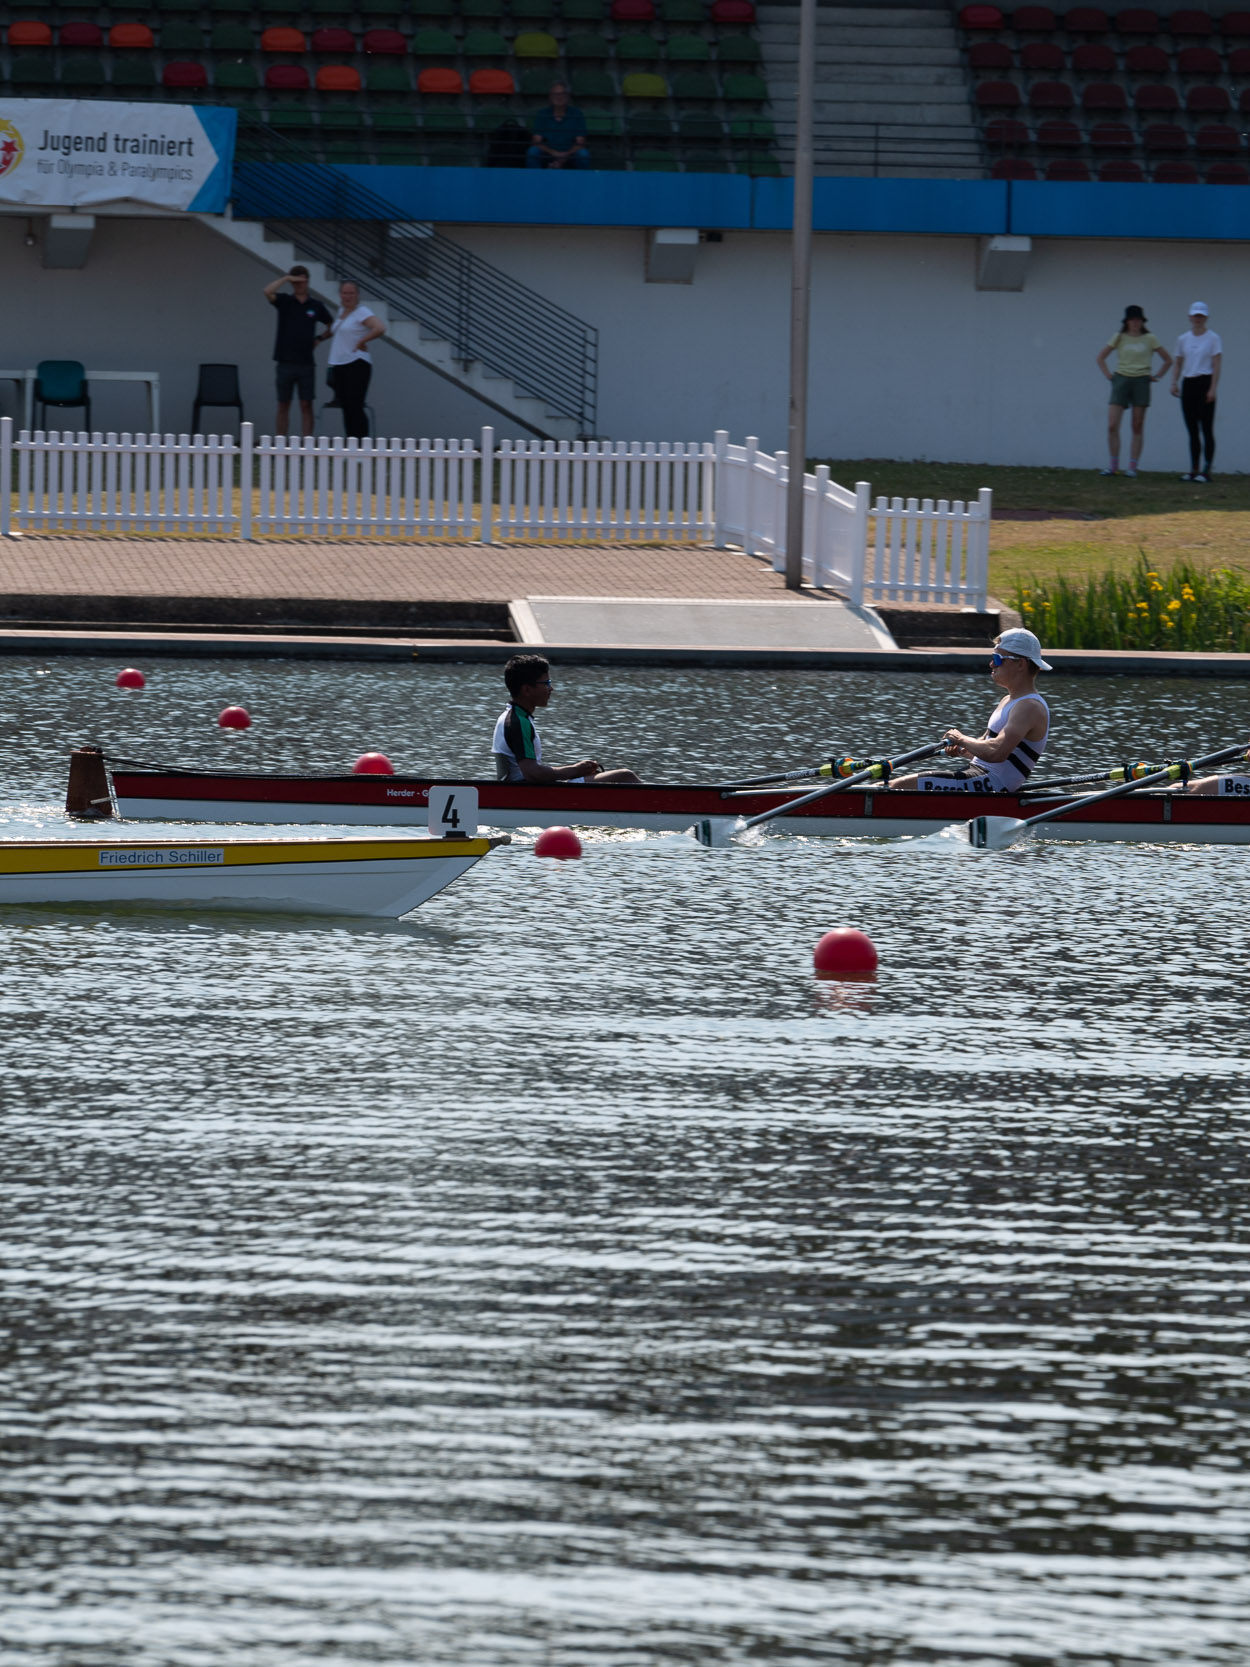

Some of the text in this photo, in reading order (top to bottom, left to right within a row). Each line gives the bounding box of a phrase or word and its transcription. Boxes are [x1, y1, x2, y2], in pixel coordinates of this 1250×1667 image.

[38, 130, 194, 157] Jugend trainiert
[37, 159, 193, 182] für Olympia & Paralympics
[387, 789, 415, 797] Herder
[973, 777, 993, 792] RC
[441, 794, 460, 828] 4
[100, 850, 222, 864] Friedrich Schiller
